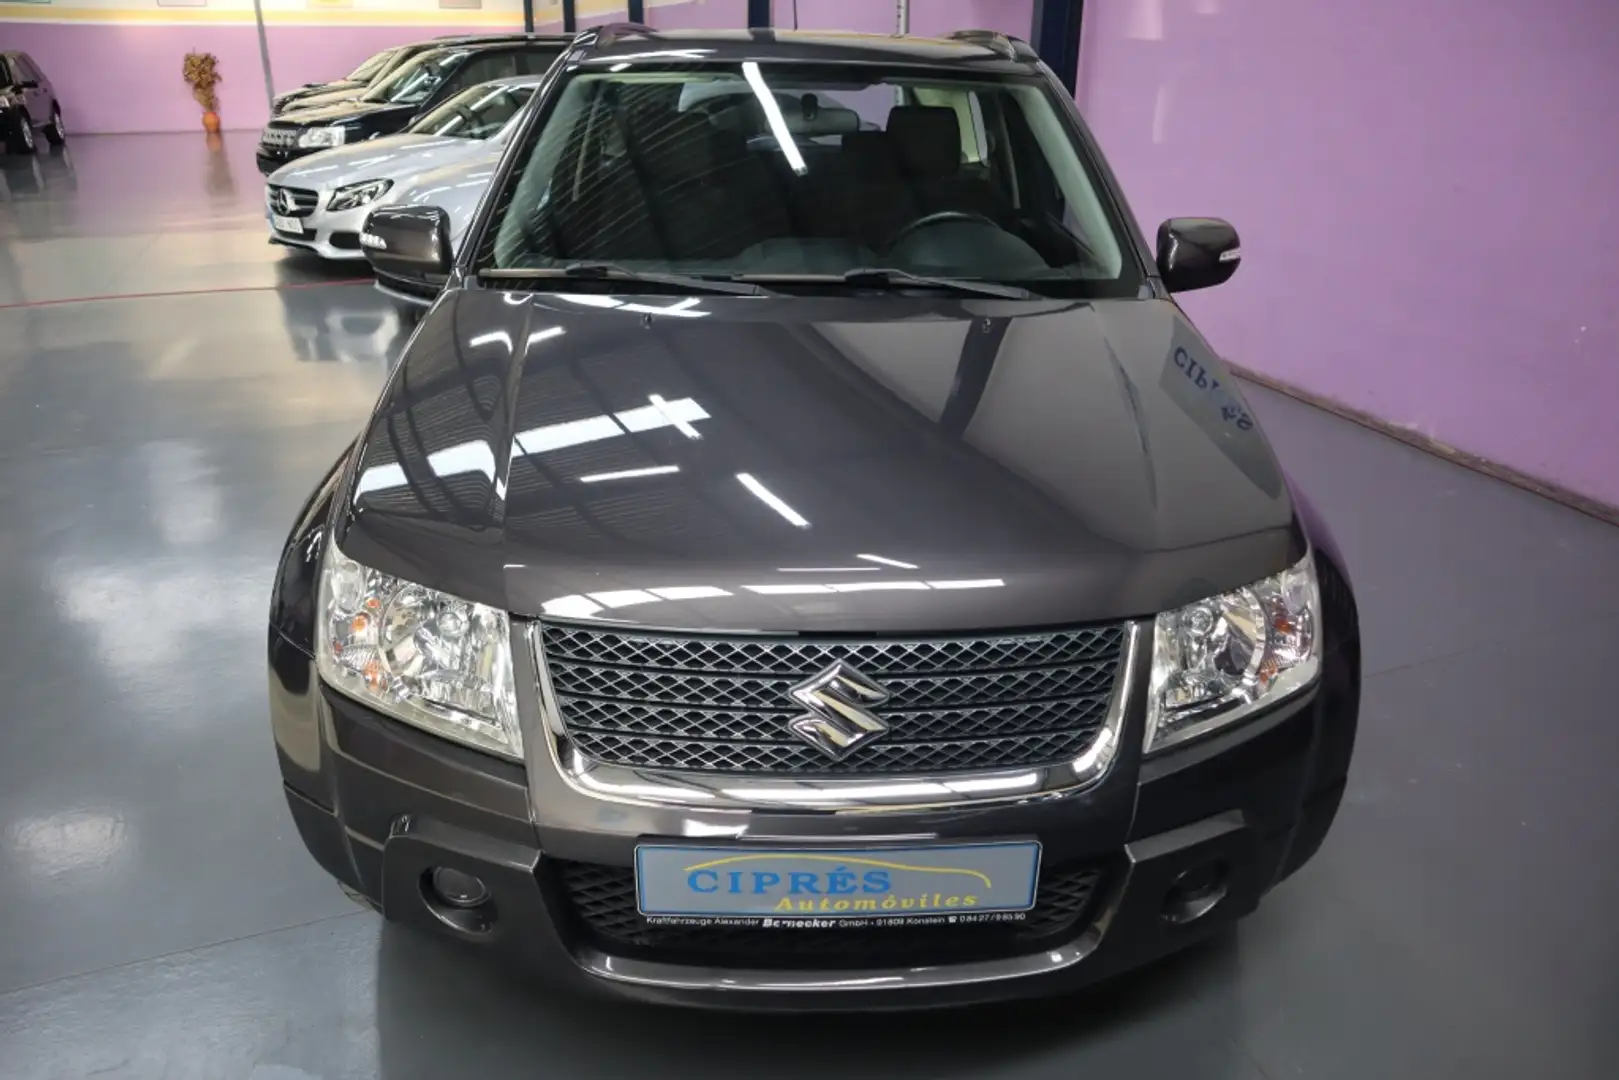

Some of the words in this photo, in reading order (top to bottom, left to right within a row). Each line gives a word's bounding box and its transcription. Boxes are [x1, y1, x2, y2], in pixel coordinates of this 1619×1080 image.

[687, 866, 891, 894] CIPRÉS
[776, 894, 978, 911] Automóviles
[714, 916, 760, 926] Alexander
[838, 918, 871, 928] GmbH
